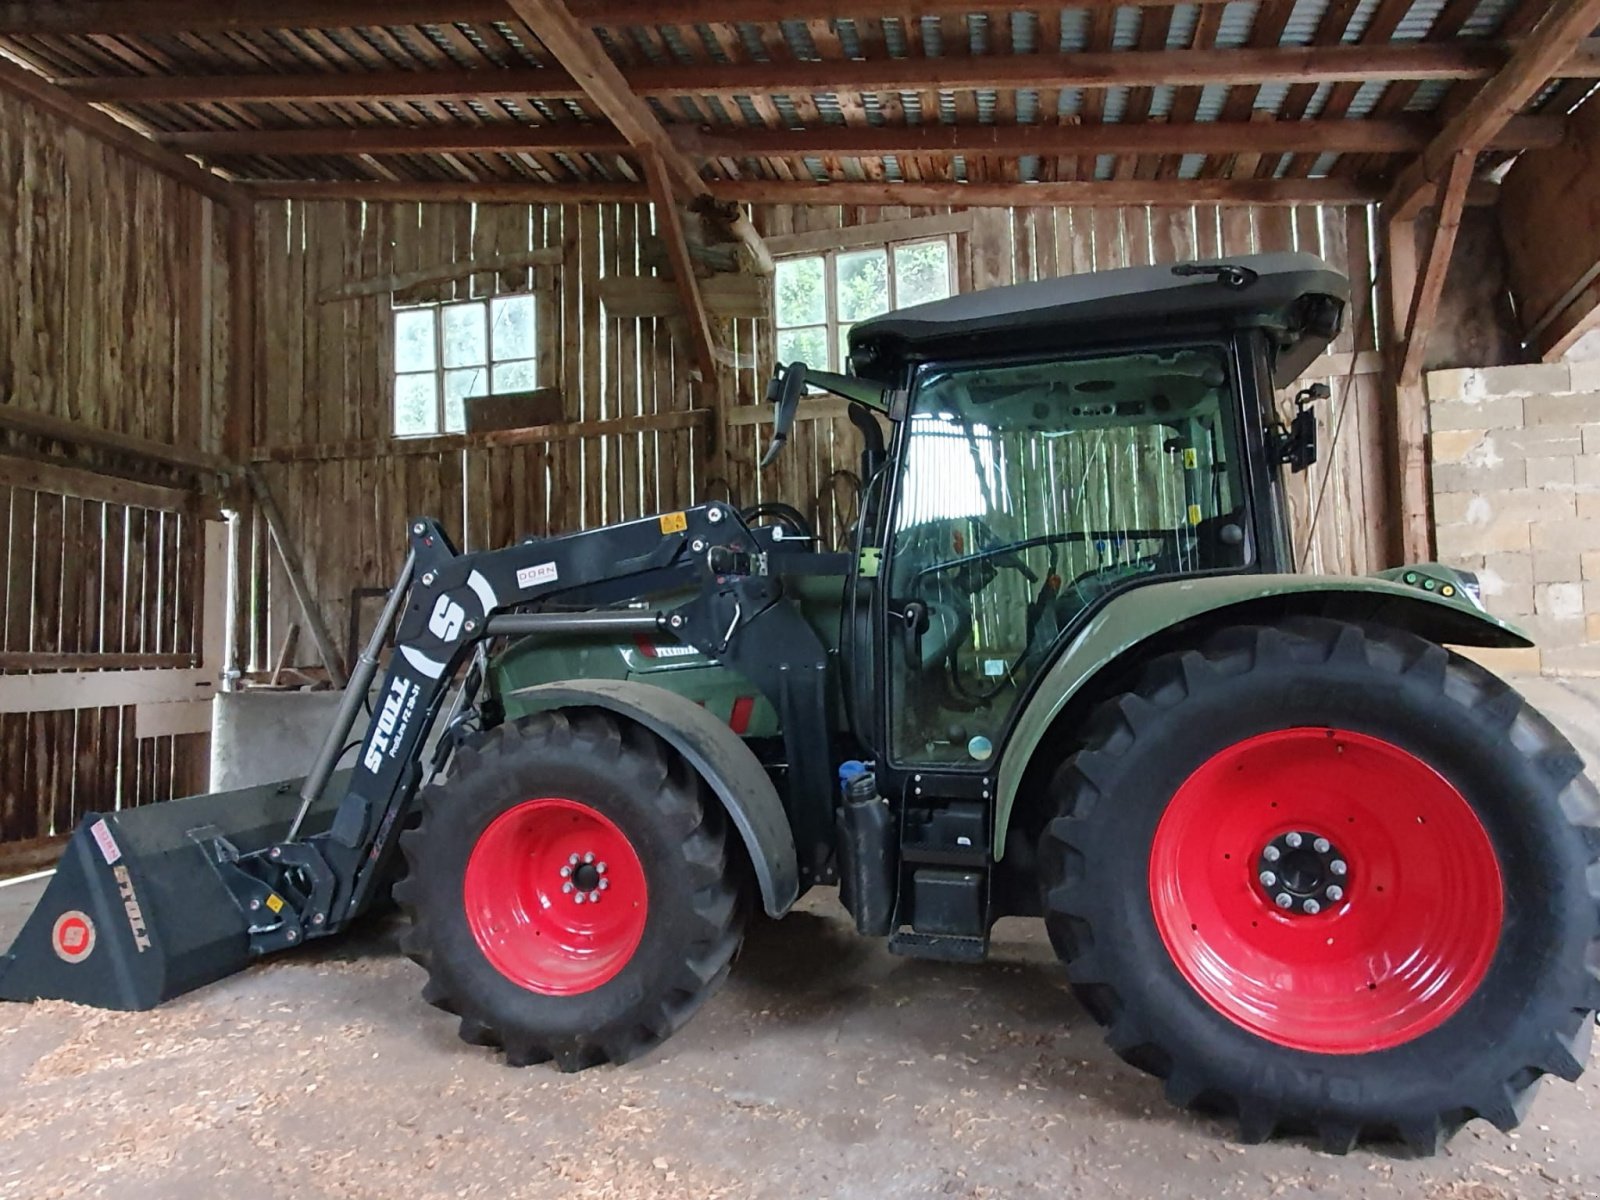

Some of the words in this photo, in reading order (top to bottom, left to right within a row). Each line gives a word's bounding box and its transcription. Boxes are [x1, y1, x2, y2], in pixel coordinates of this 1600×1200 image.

[519, 567, 555, 581] DORN
[364, 676, 410, 775] STOLL
[402, 708, 412, 723] FZ
[113, 865, 151, 953] STOLL
